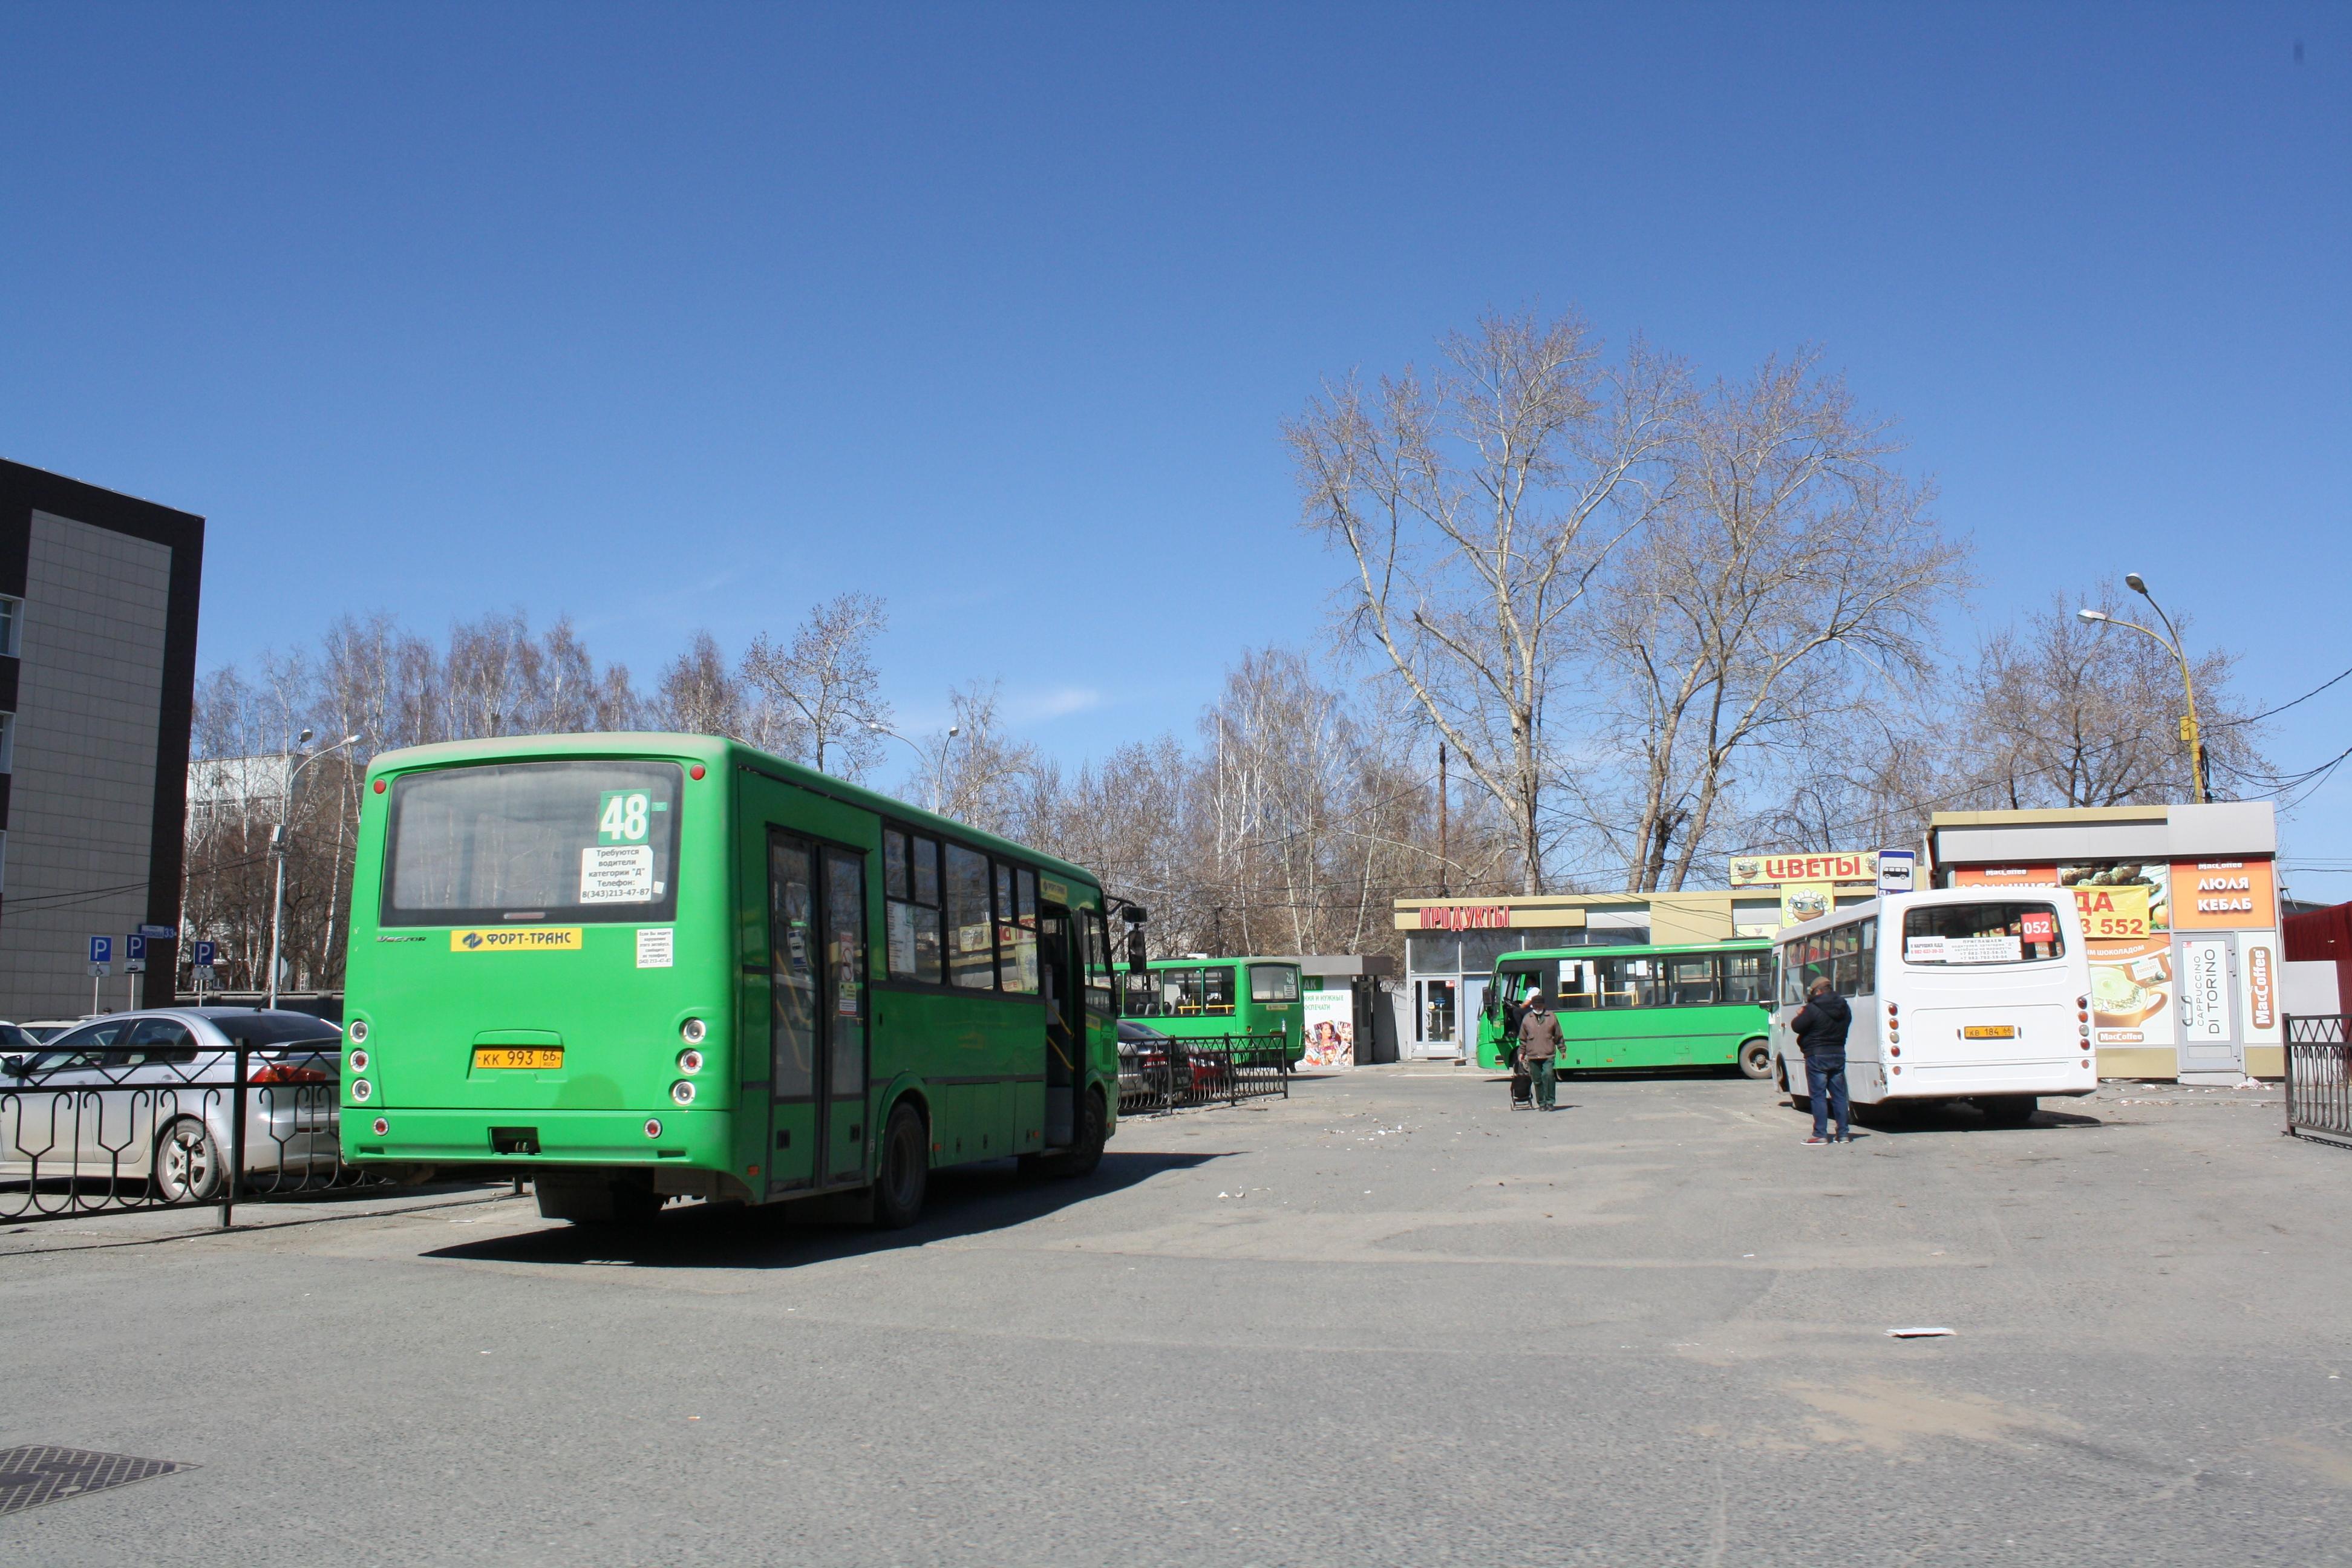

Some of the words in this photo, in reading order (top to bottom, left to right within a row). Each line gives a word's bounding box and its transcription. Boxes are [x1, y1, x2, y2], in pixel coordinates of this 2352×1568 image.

[599, 794, 648, 840] 48
[596, 849, 639, 858] Требуются
[632, 867, 645, 876] "Д"
[1766, 857, 1861, 878] ЦВЕТЫ
[2198, 877, 2249, 890] ЛЮЛЯ
[582, 888, 650, 900] 8(343)213-47-87
[2198, 898, 2252, 911] КЕБАБ
[1420, 906, 1509, 932] ПРОДУКТЫ
[2024, 921, 2050, 935] 052
[2100, 918, 2144, 935] 552
[486, 932, 572, 945] ФОРТ-ТРАНС
[2097, 944, 2145, 956] ШОКОЛАДОМ
[2204, 949, 2218, 1012] TORINO
[2253, 950, 2270, 1024] MacCoffee
[2194, 956, 2204, 1027] CAPPUCCINO
[2209, 1020, 2220, 1034] DI
[483, 1054, 500, 1065] КК
[507, 1050, 534, 1065] 993
[542, 1050, 556, 1061] 66
